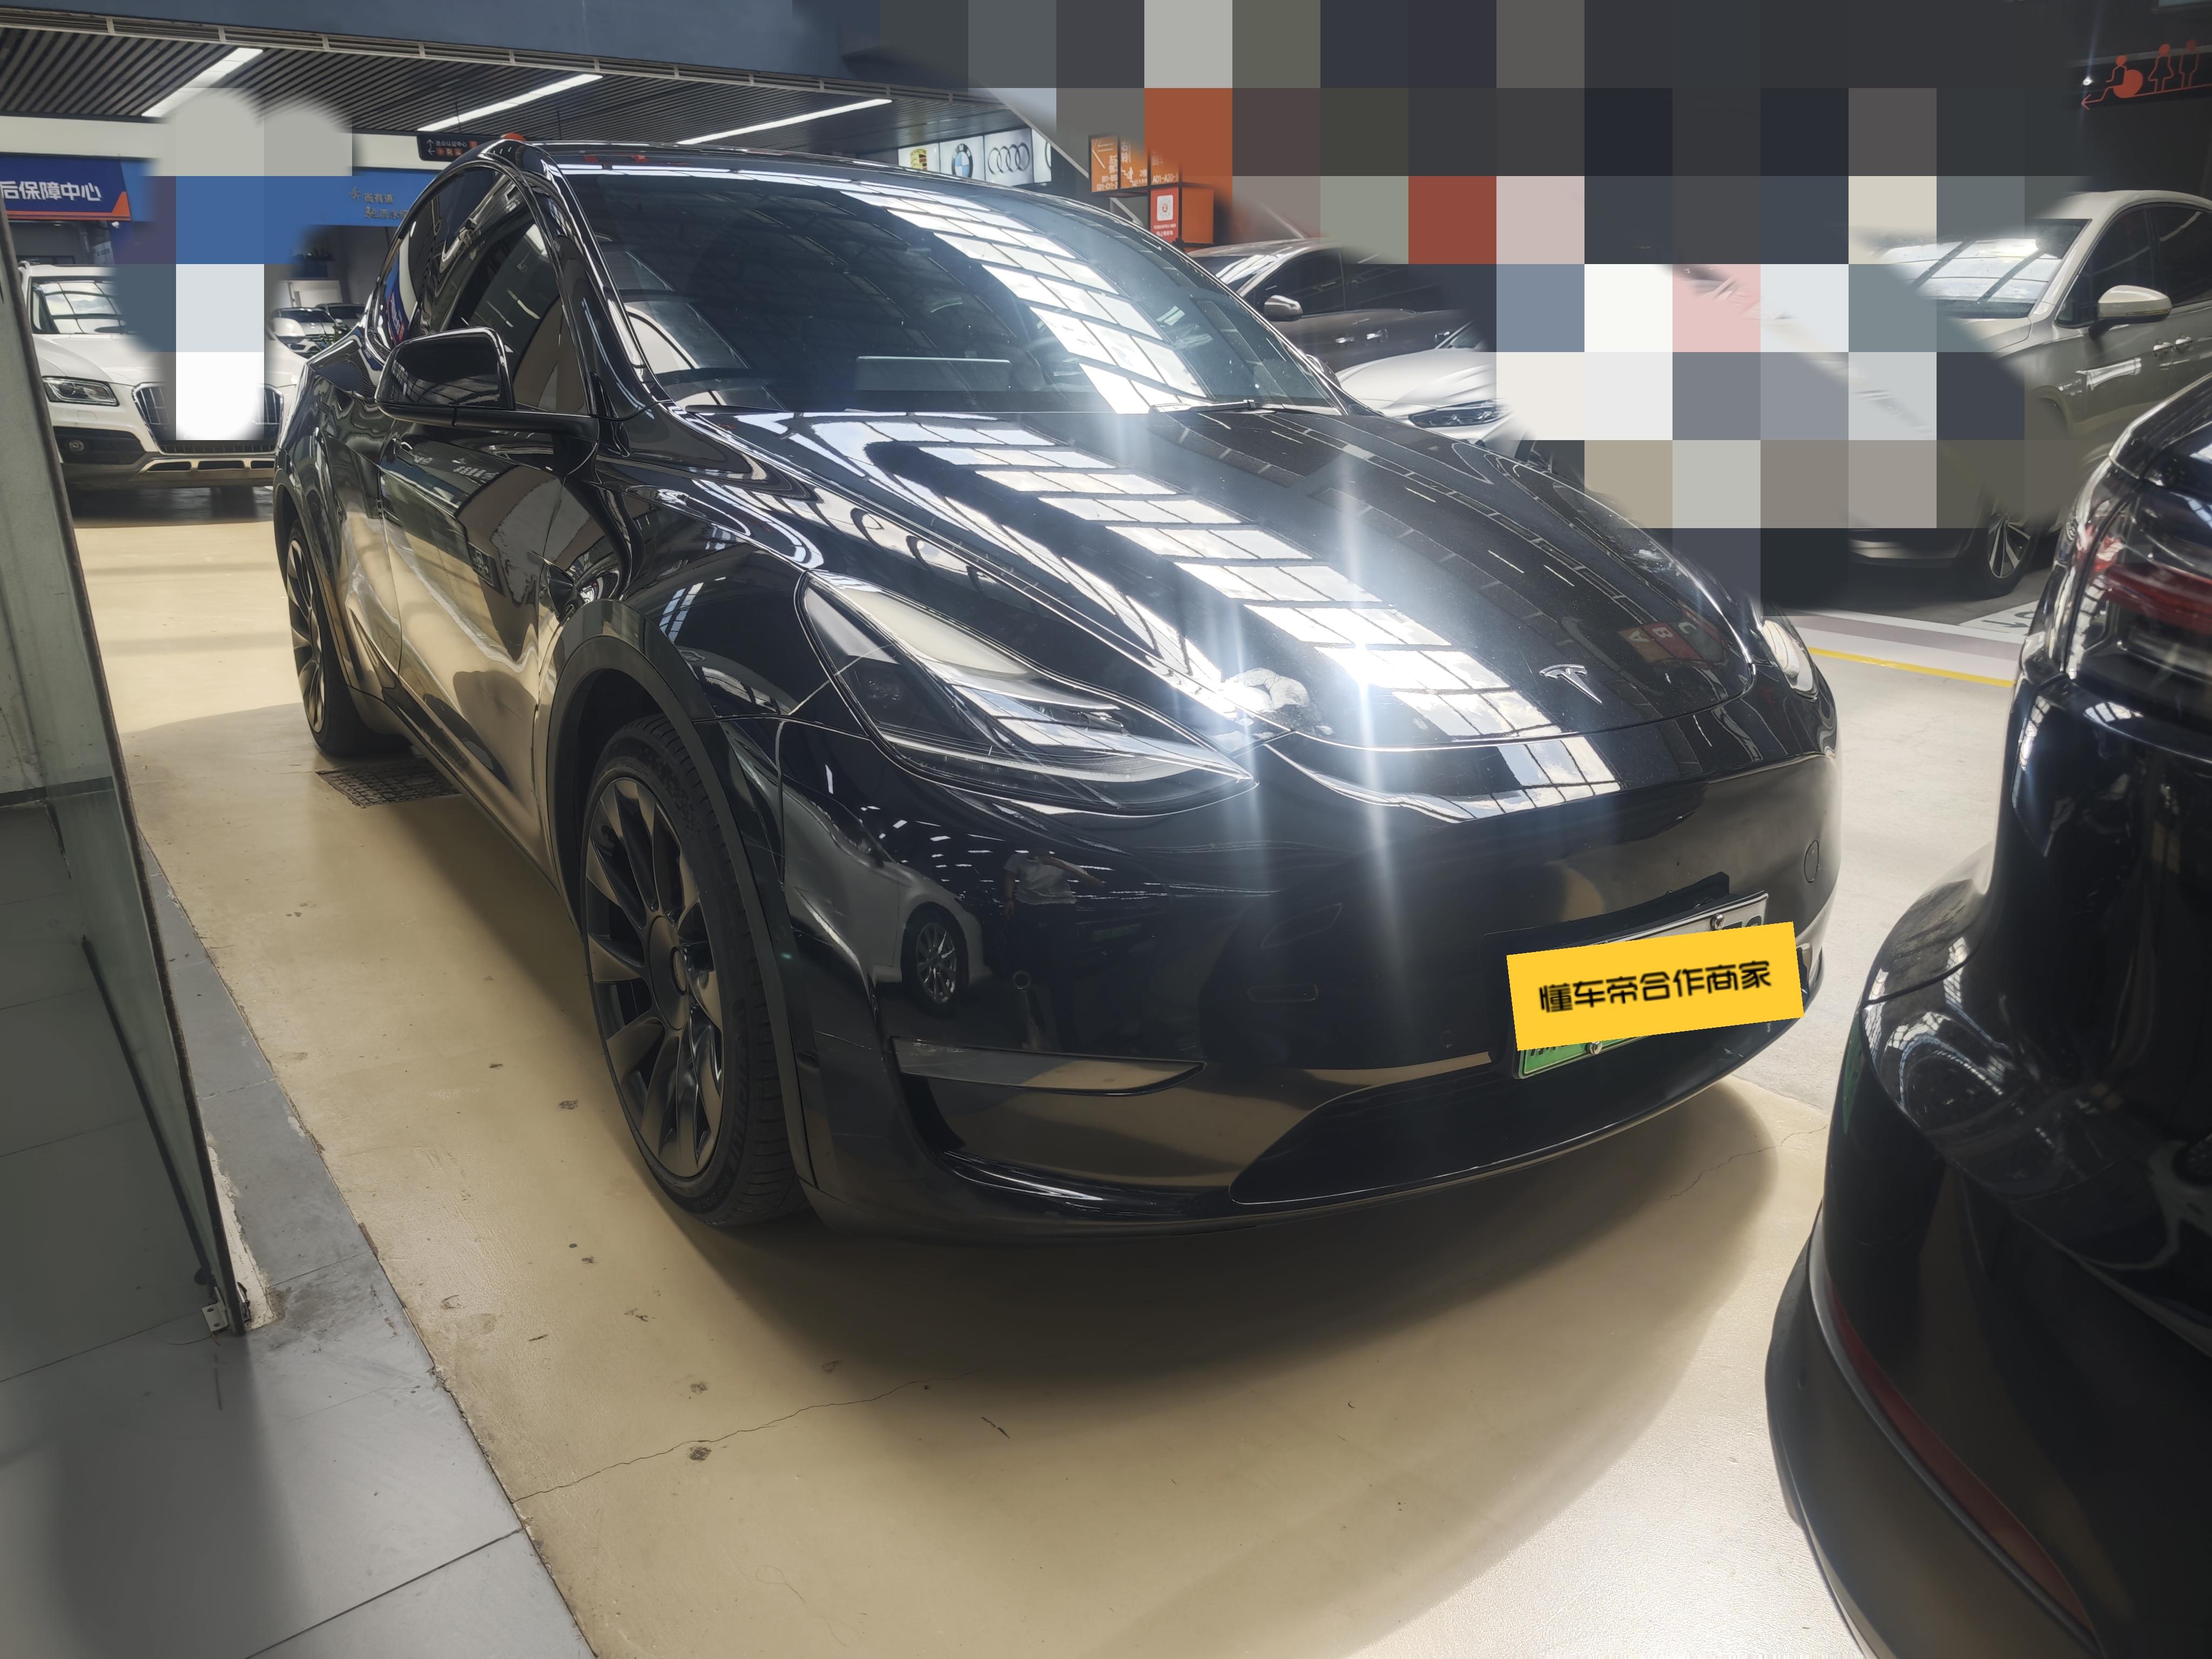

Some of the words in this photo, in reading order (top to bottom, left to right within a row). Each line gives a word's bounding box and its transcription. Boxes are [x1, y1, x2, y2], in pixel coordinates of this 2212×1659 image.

[0, 181, 103, 201] 后保障中心
